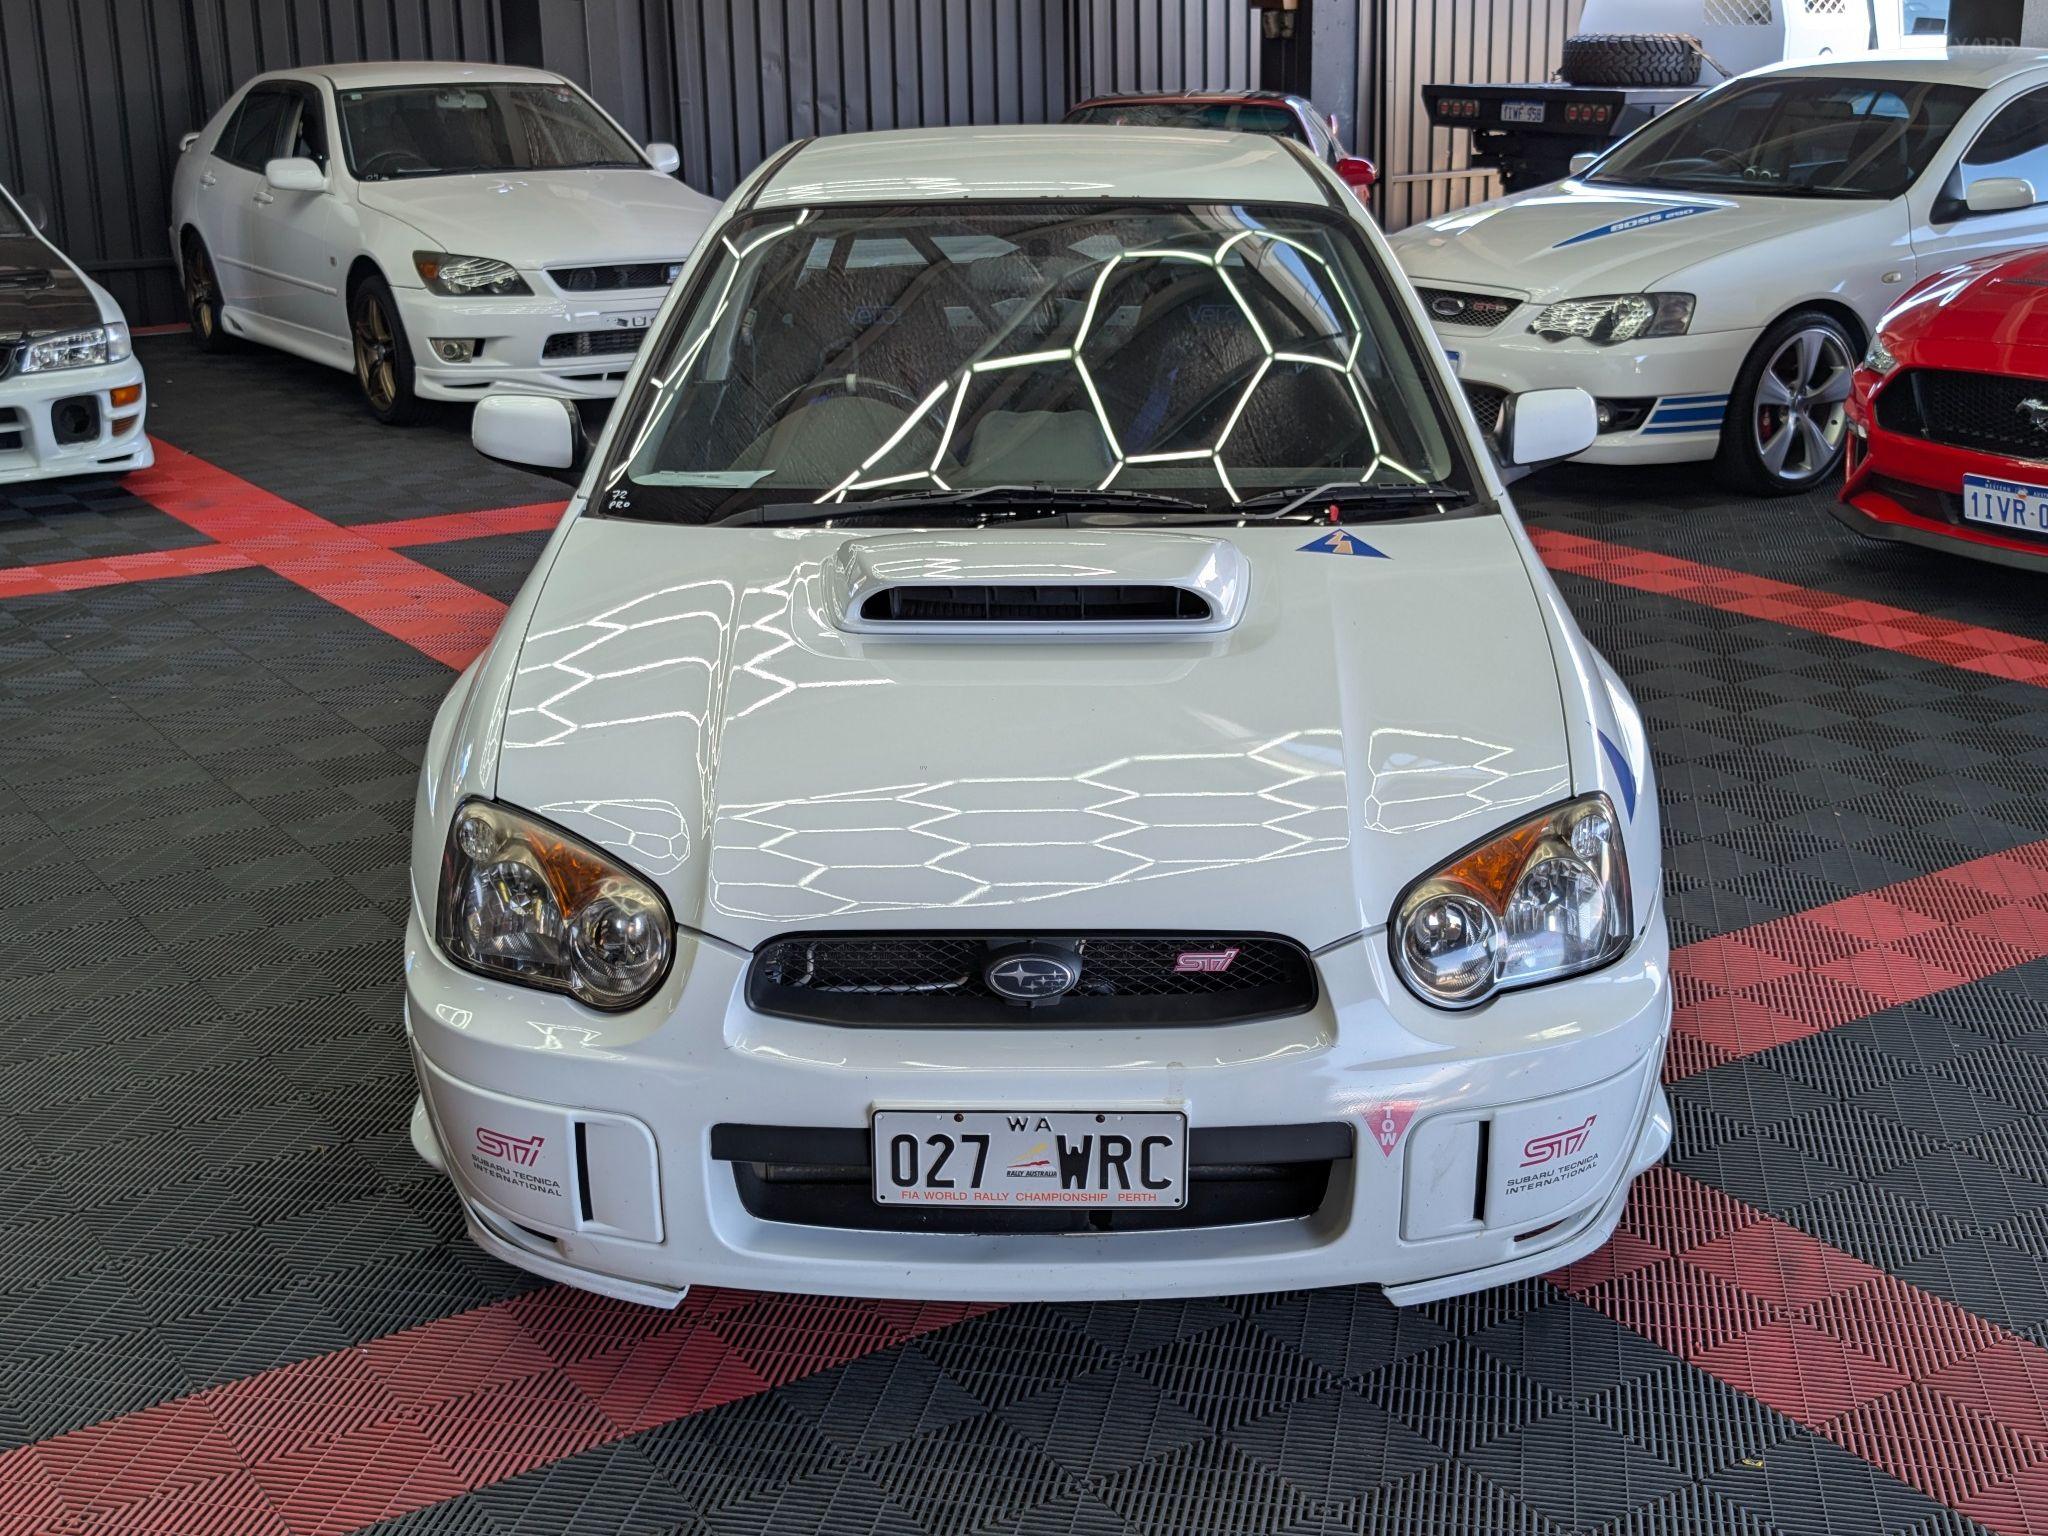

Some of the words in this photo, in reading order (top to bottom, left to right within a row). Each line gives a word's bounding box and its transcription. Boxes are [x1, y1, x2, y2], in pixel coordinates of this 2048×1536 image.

[1610, 213, 1662, 232] BOSS
[608, 501, 631, 510] PRO
[612, 489, 628, 500] 72
[1380, 1105, 1397, 1146] TOW
[471, 1153, 511, 1175] SUBARU
[513, 1170, 561, 1188] TECNICA
[891, 1133, 991, 1189] 027
[1056, 1134, 1175, 1190] WRC
[1506, 1169, 1555, 1187] SUBARU
[1558, 1153, 1600, 1173] TECNICA
[473, 1162, 563, 1197] INTERNATIONAL
[1505, 1162, 1598, 1195] INTERNATIONAL
[901, 1190, 920, 1200] FIA
[924, 1191, 968, 1201] WORLD
[974, 1191, 1009, 1201] RALLY
[1015, 1191, 1108, 1202] CHAMPIONSHIP
[1118, 1192, 1157, 1202] PERTH
